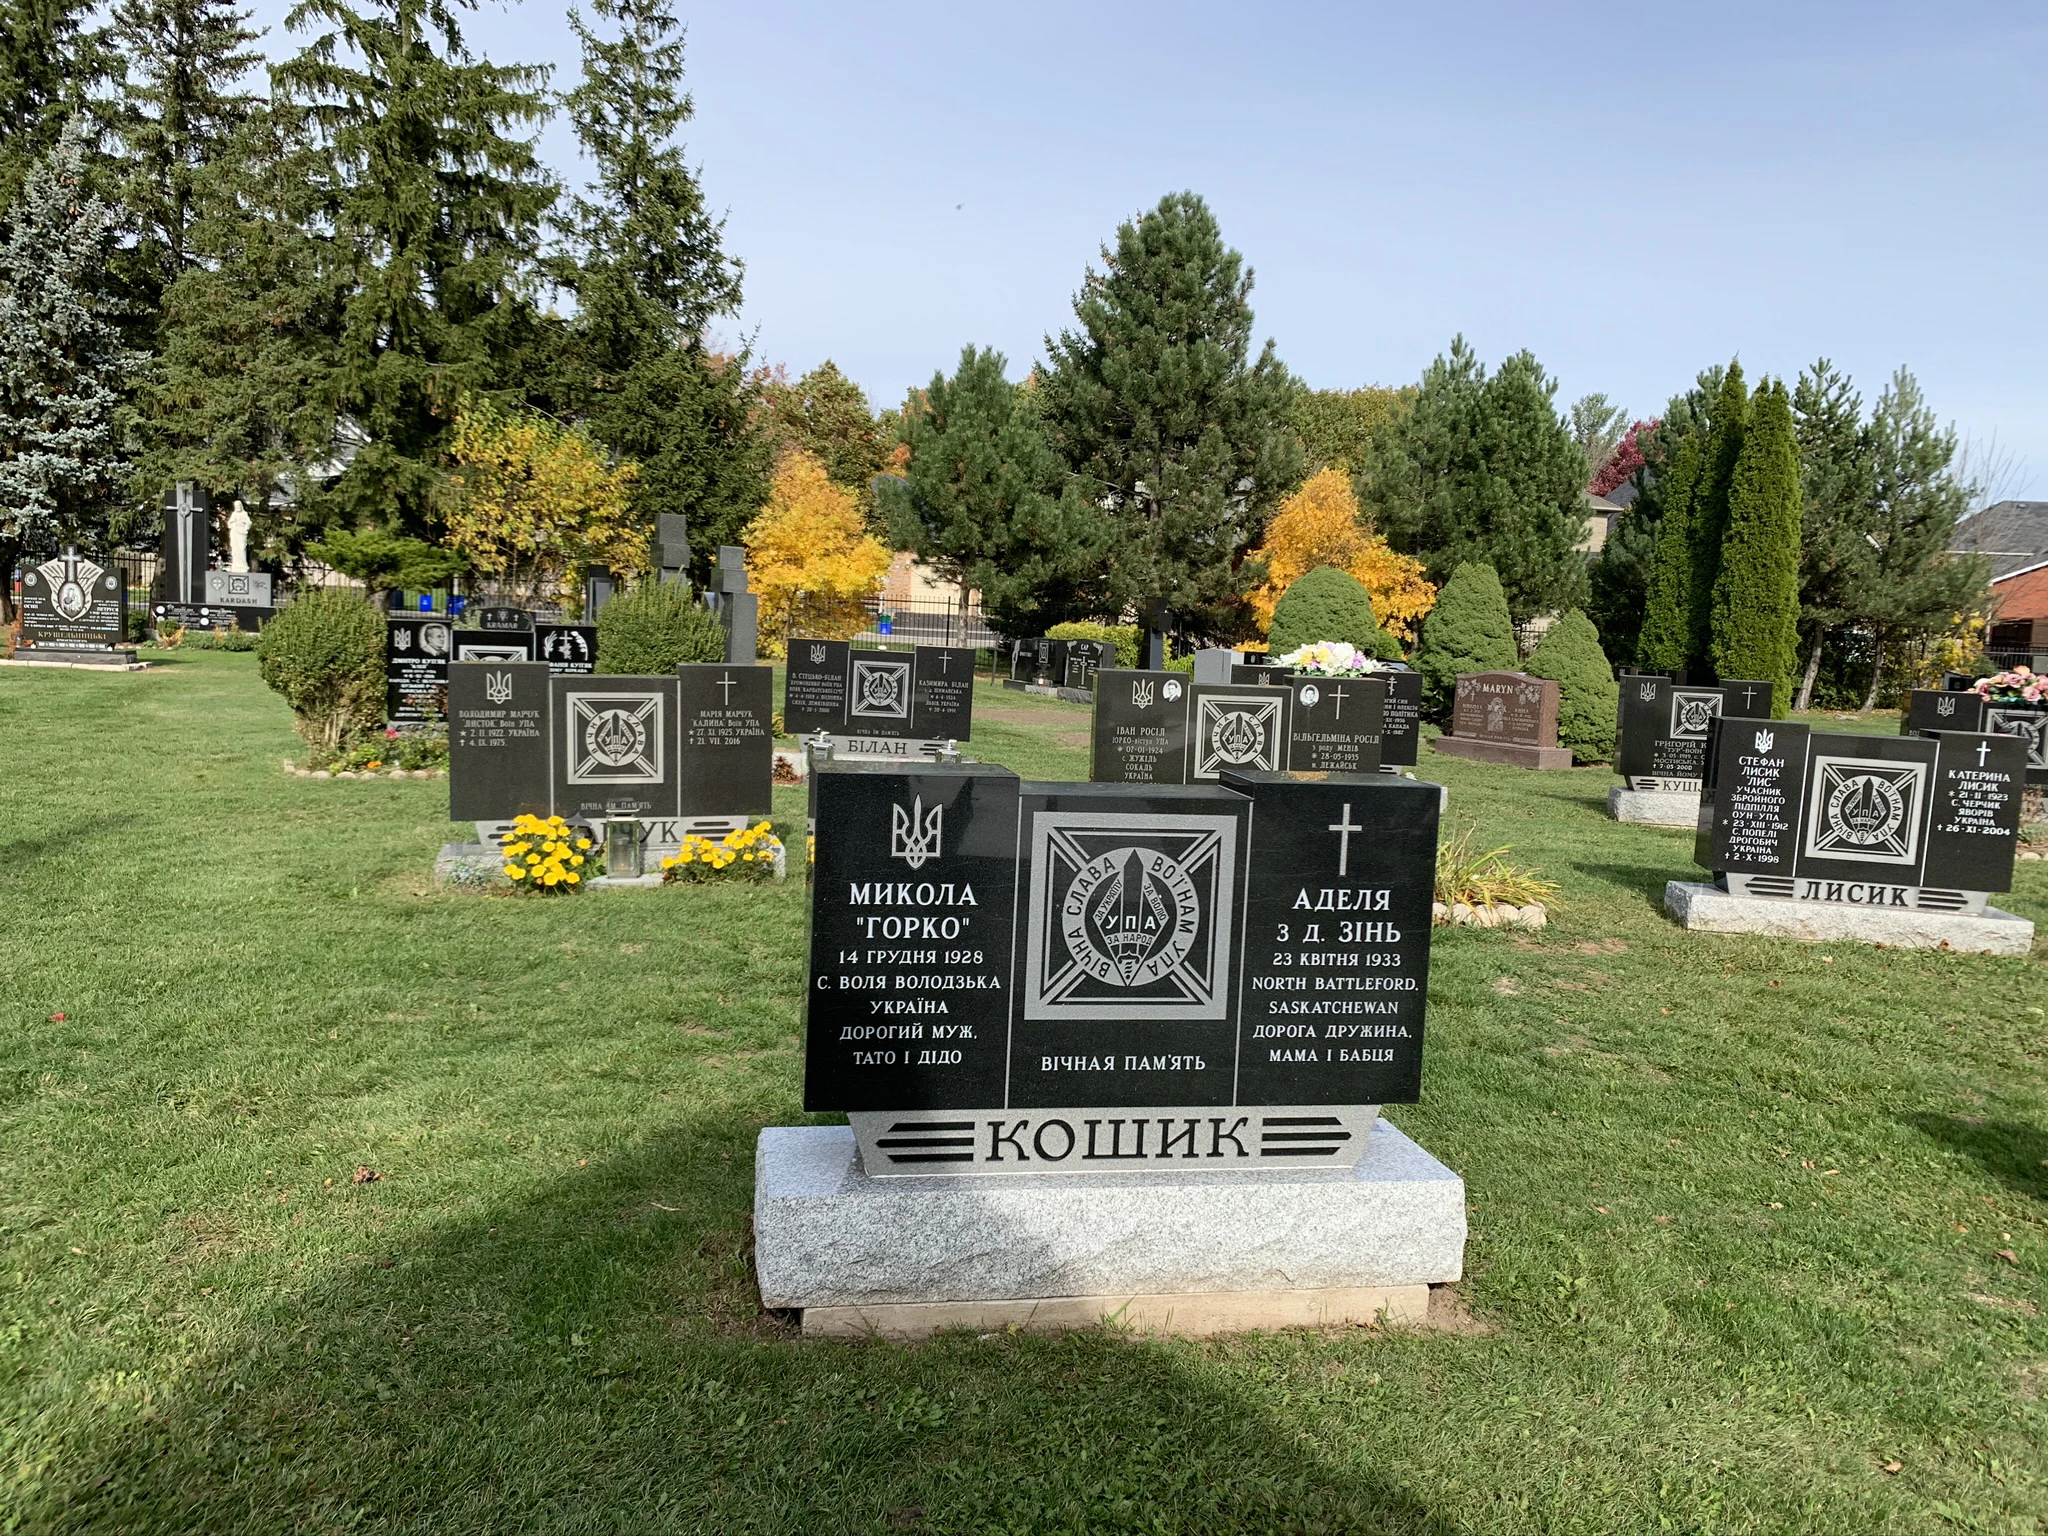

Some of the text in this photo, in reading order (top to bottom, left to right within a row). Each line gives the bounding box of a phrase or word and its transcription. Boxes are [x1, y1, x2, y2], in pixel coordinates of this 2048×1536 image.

[220, 597, 257, 605] KARDASH
[1482, 683, 1514, 694] MARYN
[459, 710, 540, 718] ВОЛОДИМИР МАРЧУК
[700, 710, 753, 718] МАРІЯ МАРЧУК
[519, 720, 535, 728] УПА
[508, 728, 540, 737] УКРАЇНА
[587, 715, 605, 754] ВІЧНА
[626, 714, 644, 755] СЛАВА
[735, 727, 765, 736] УКРАЇНА
[1116, 726, 1165, 736] ІВАН РОСІЛ
[1293, 732, 1379, 744] ВІЛЬГЕЛЬМІНА РОСІЛ
[848, 740, 908, 755] БІЛАН
[1655, 740, 1696, 749] ГРИГОРІЙ
[1129, 755, 1157, 763] ЖУЖІЛЬ
[1319, 761, 1357, 769] ЛЕЖАЙСЬК
[1739, 756, 1785, 767] СТЕФАН
[1125, 763, 1153, 771] СОКАЛЬ
[1741, 766, 1780, 777] ЛИСИК
[1124, 772, 1153, 780] УКРАЇНА
[1676, 770, 1698, 778] ЙОМУ
[1948, 769, 2010, 782] КАТЕРИНА
[1746, 776, 1776, 787] "ЛИС"
[1958, 781, 1999, 792] ЛИСИК
[1736, 785, 1782, 796] УЧАСНИК
[1830, 779, 1860, 808] СЛАВА
[1731, 793, 1786, 805] ЗБРОЙНОГО
[1951, 799, 2001, 810] С. ЧЕРЧИК
[580, 802, 602, 811] ВІЧНА
[1734, 802, 1780, 813] ПІДПІЛЛЯ
[1958, 808, 1994, 817] ЯВОРІВ
[1852, 809, 1879, 818] УПА
[1830, 812, 1854, 840] ВІЧНА
[1871, 823, 1895, 841] УПА
[1742, 828, 1777, 838] ПОПЕЛІ
[1728, 836, 1778, 846] ДРОГОБИЧ
[849, 883, 979, 906] МИКОЛА
[1292, 888, 1391, 912] АДЕЛЯ
[1801, 881, 1909, 907] ЛИСИК
[1143, 883, 1167, 921] ЗА ВОЛЮ
[1066, 855, 1195, 978] ВІЧНА СЛАВА ВОЇНАМ УПА
[1105, 915, 1156, 929] УПА
[856, 916, 970, 939] "ГОРКО"
[1276, 921, 1401, 944] З Д. ЗІНЬ
[1107, 933, 1153, 946] ЗА НАРОД
[839, 950, 983, 965] 14 ГРУДНЯ 1928
[1272, 952, 1401, 967] 23 КВІТНЯ 1933
[817, 975, 1001, 991] С. ВОЛЯ ВОЛОДЗЬКА
[1252, 976, 1307, 990] NORTH
[870, 998, 949, 1014] УКРАЇНА
[1269, 1001, 1399, 1014] SASKATCHEWAN
[839, 1022, 923, 1040] ДОРОГИЙ
[1252, 1024, 1317, 1039] ДОРОГА
[853, 1051, 962, 1065] ТАТО І ДІДО
[1269, 1048, 1394, 1063] МАМА І БАБЦЯ
[1041, 1054, 1206, 1071] ВІЧНАЯ ПАМ'ЯТЬ
[985, 1117, 1250, 1162] КОШИК
